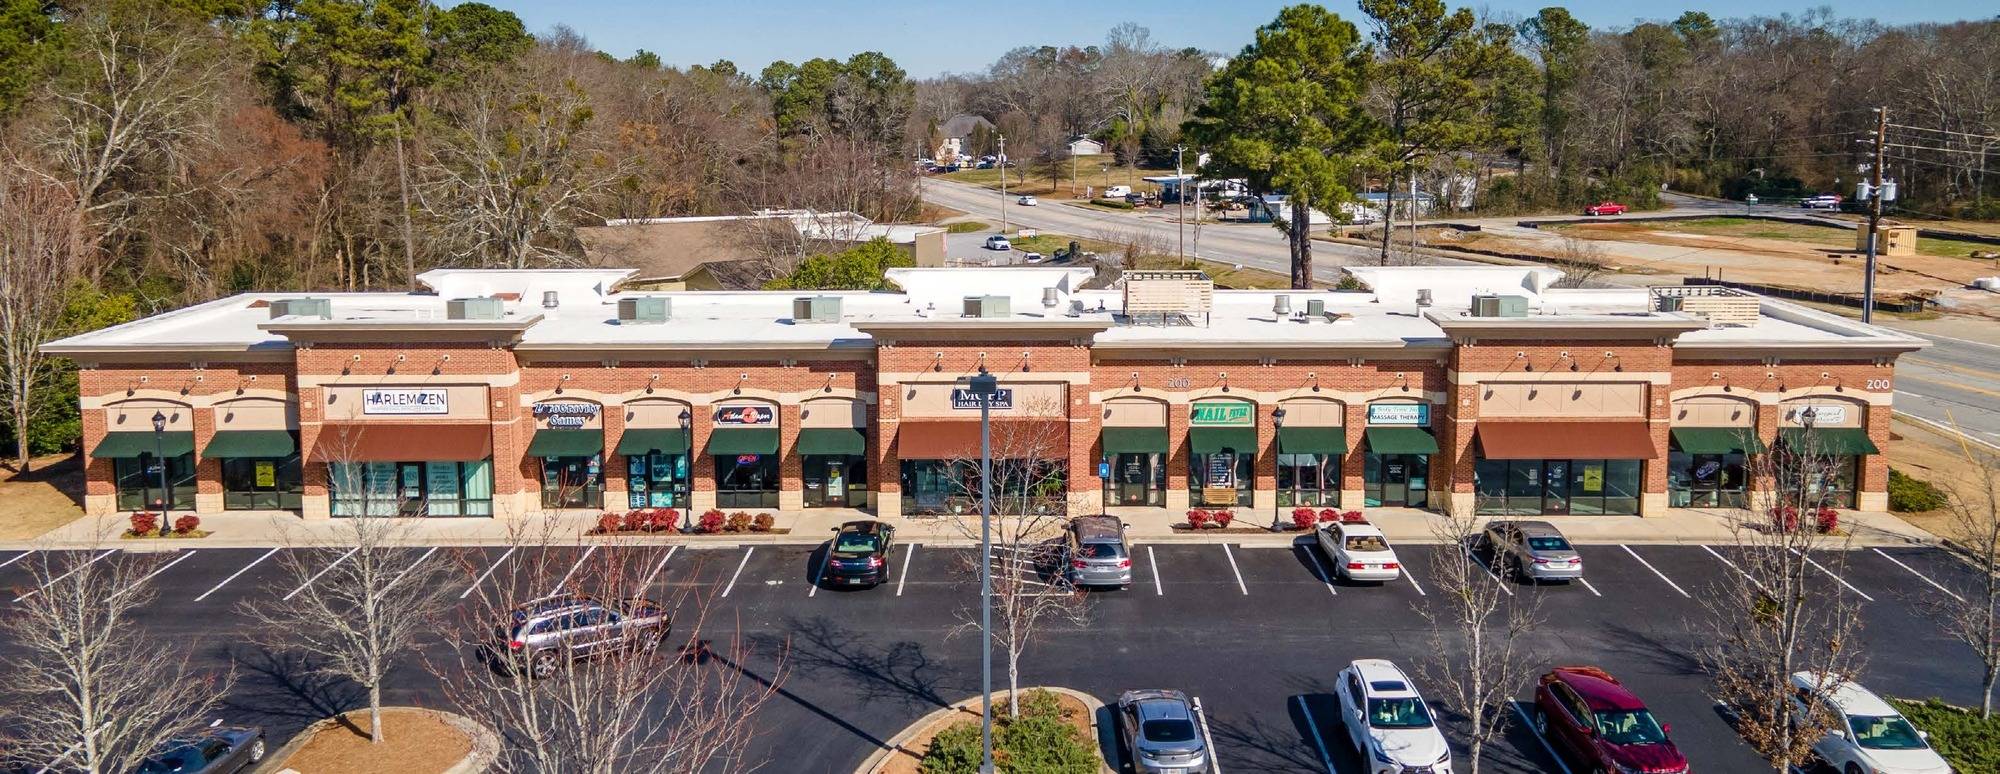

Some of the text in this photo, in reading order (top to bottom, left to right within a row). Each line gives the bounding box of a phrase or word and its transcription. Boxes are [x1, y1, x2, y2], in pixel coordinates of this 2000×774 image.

[1167, 379, 1189, 389] 200
[1866, 379, 1890, 389] 200
[366, 393, 445, 405] HARLEM ZEN
[549, 414, 585, 426] Games
[1195, 407, 1226, 421] NAIL
